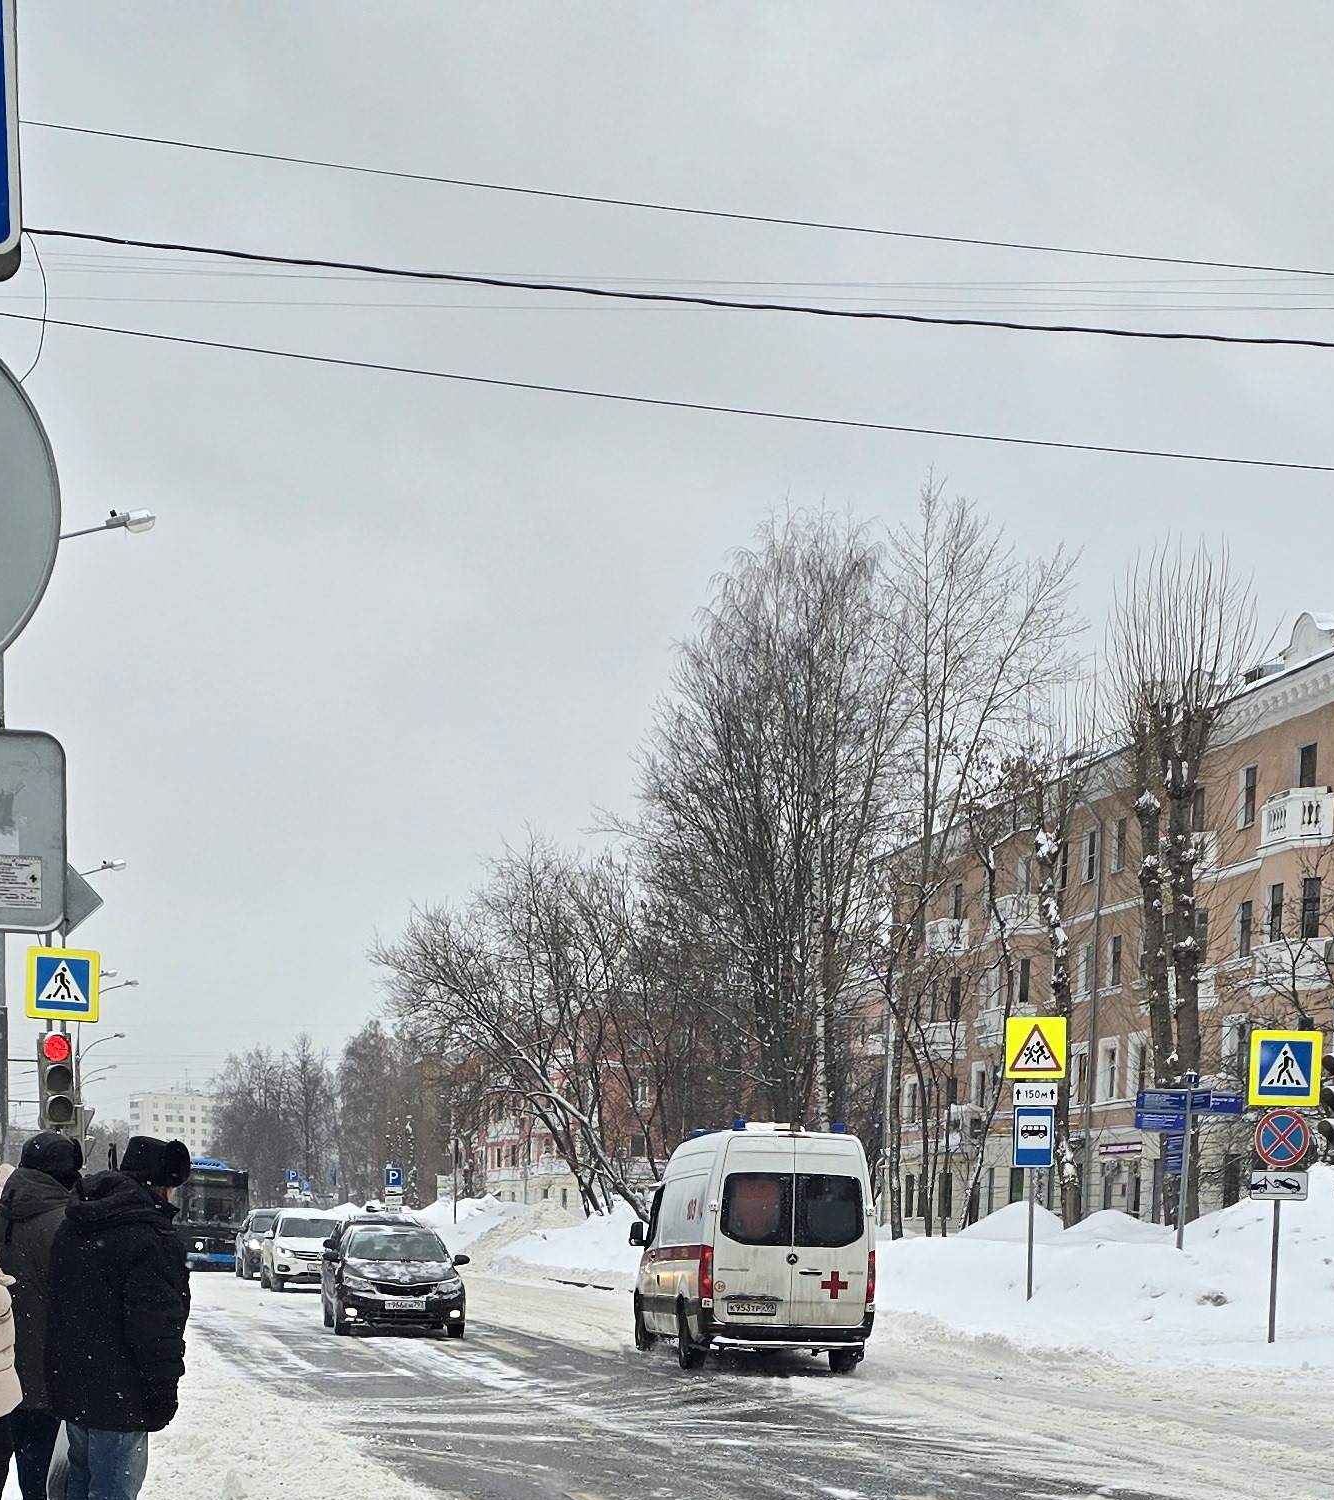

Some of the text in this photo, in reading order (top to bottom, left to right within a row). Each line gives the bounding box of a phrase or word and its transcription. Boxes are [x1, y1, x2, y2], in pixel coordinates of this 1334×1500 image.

[1024, 1089, 1048, 1099] 150м
[289, 1170, 297, 1181] P
[389, 1170, 399, 1184] P
